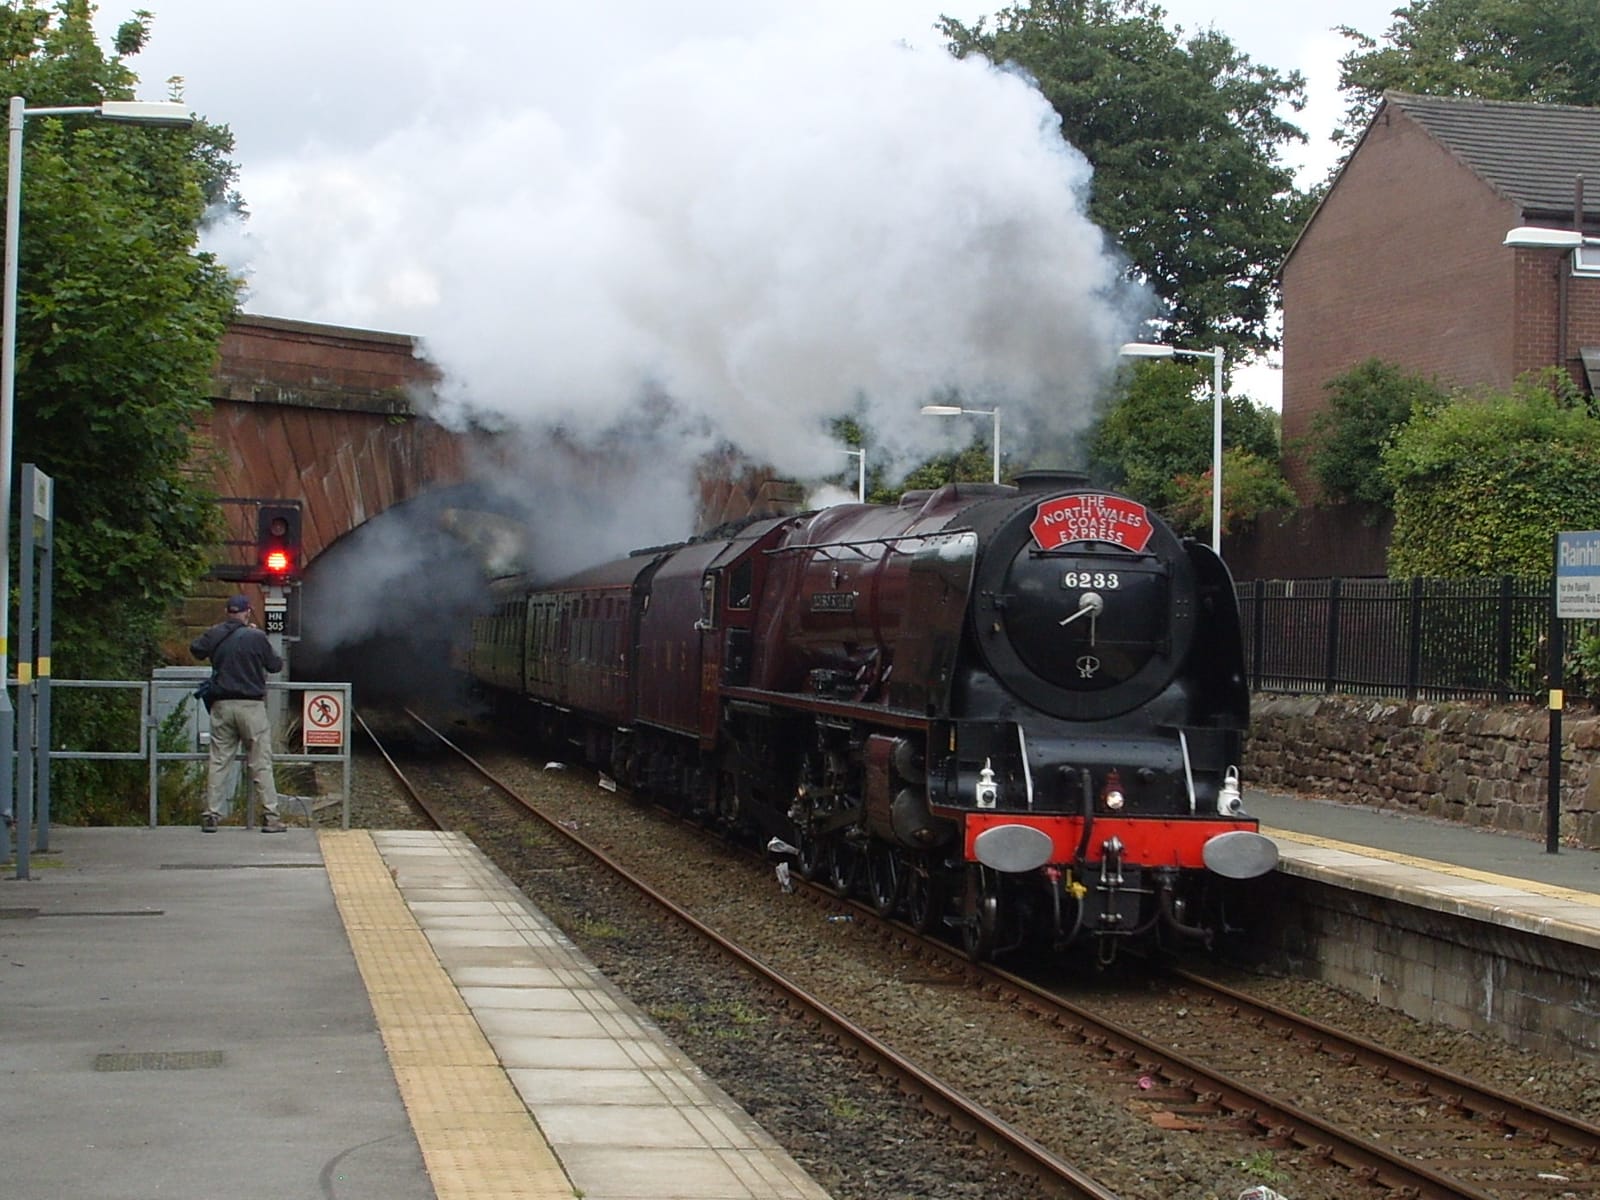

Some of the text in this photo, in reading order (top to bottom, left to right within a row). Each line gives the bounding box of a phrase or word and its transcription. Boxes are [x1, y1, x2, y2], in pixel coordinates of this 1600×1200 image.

[1077, 496, 1105, 507] THE
[1043, 506, 1142, 527] NORTH WALES
[1068, 518, 1117, 529] COAST
[1059, 528, 1124, 543] EXPRESS
[1065, 572, 1119, 589] 6233
[268, 612, 283, 621] HN
[266, 621, 284, 631] 305
